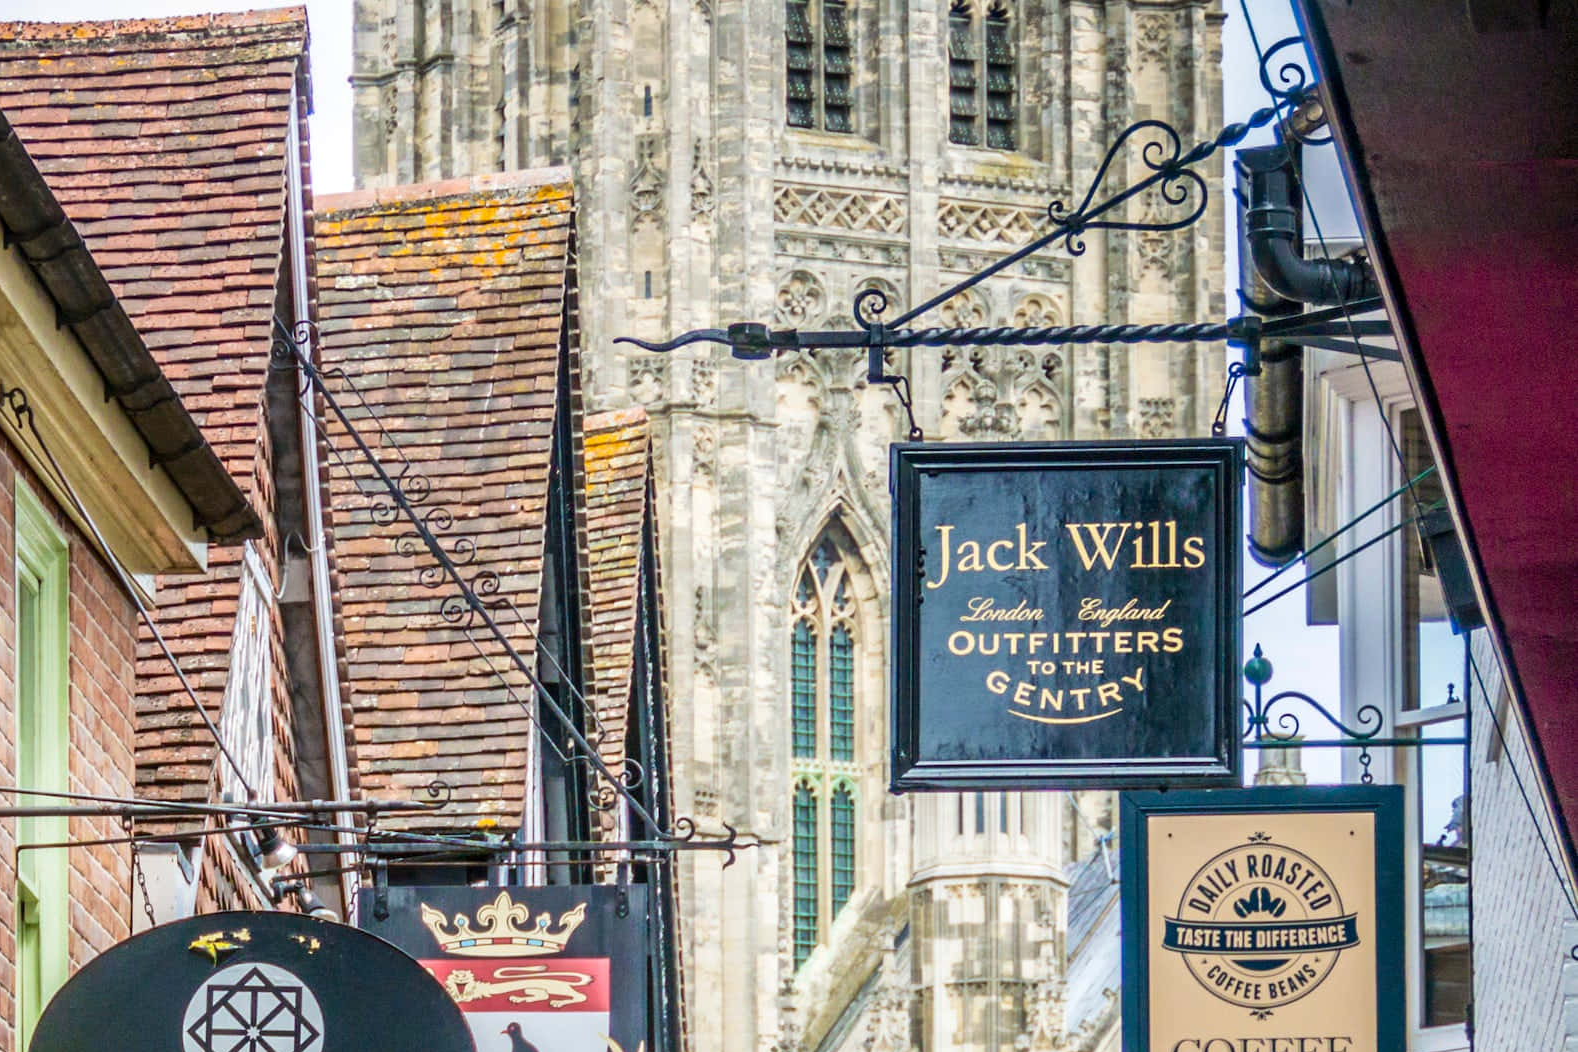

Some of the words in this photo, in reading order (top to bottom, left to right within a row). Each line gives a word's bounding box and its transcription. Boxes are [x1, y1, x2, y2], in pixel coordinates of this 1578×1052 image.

[926, 523, 1049, 590] Jack
[1065, 520, 1206, 572] Wills
[960, 597, 1044, 622] London
[1077, 597, 1172, 628] England
[948, 626, 1184, 656] OUTFITTERS
[1027, 660, 1054, 675] TO
[1062, 659, 1105, 675] THE
[986, 666, 1146, 712] GENTRY
[1189, 859, 1240, 914] DAILY
[1247, 853, 1332, 912] ROASTED
[1176, 925, 1221, 948] TASTE
[1224, 928, 1252, 948] THE
[1255, 923, 1346, 948] DIFFERENCE
[1206, 964, 1262, 1001] COFFEE
[1268, 963, 1317, 1000] BEANS
